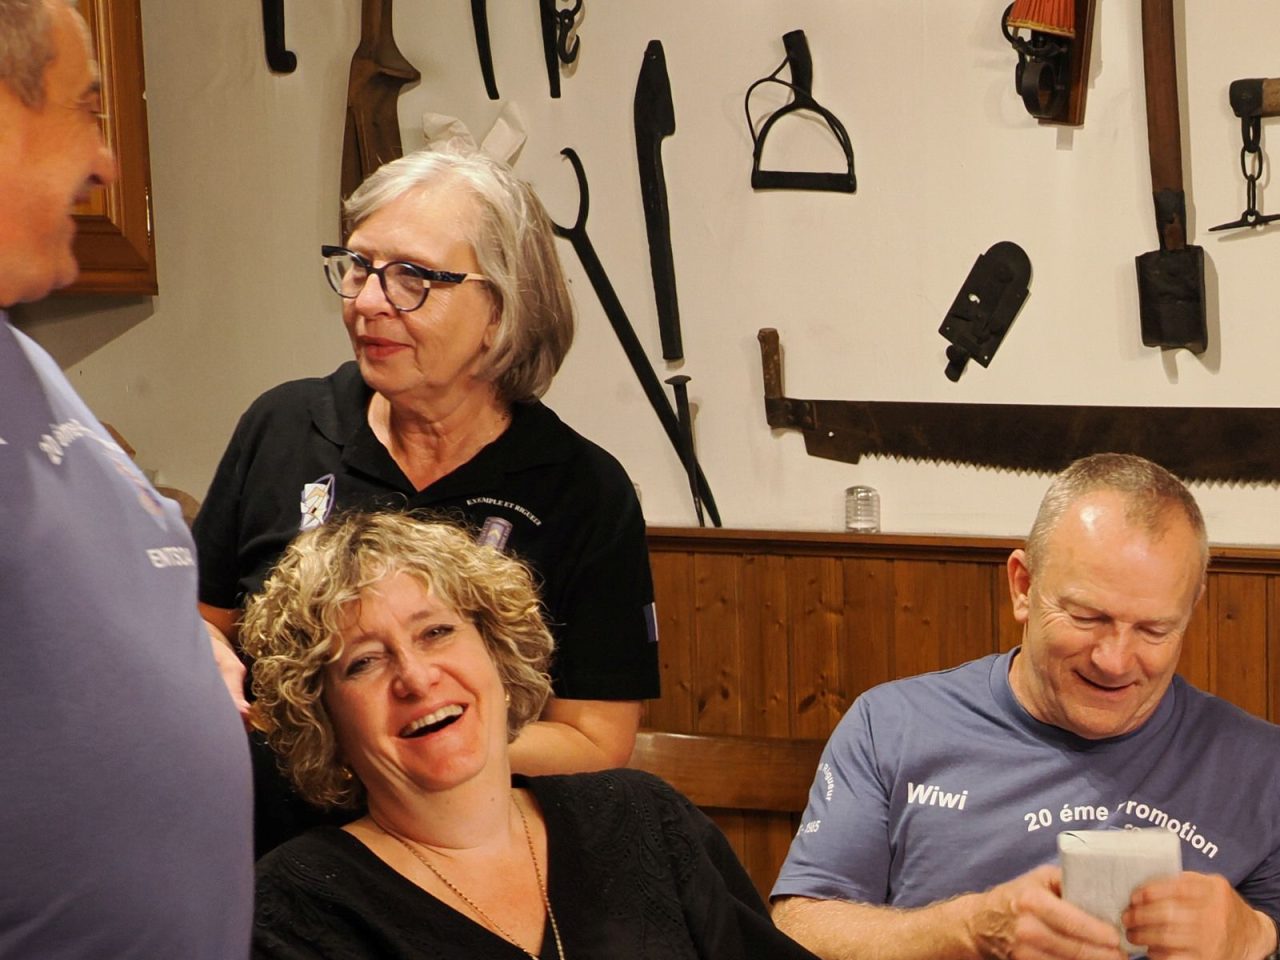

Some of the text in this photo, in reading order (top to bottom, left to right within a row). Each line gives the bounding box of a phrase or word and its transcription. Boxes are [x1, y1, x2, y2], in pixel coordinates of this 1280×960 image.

[907, 782, 969, 810] Wiwi
[1024, 800, 1219, 859] 20 éme romotion
